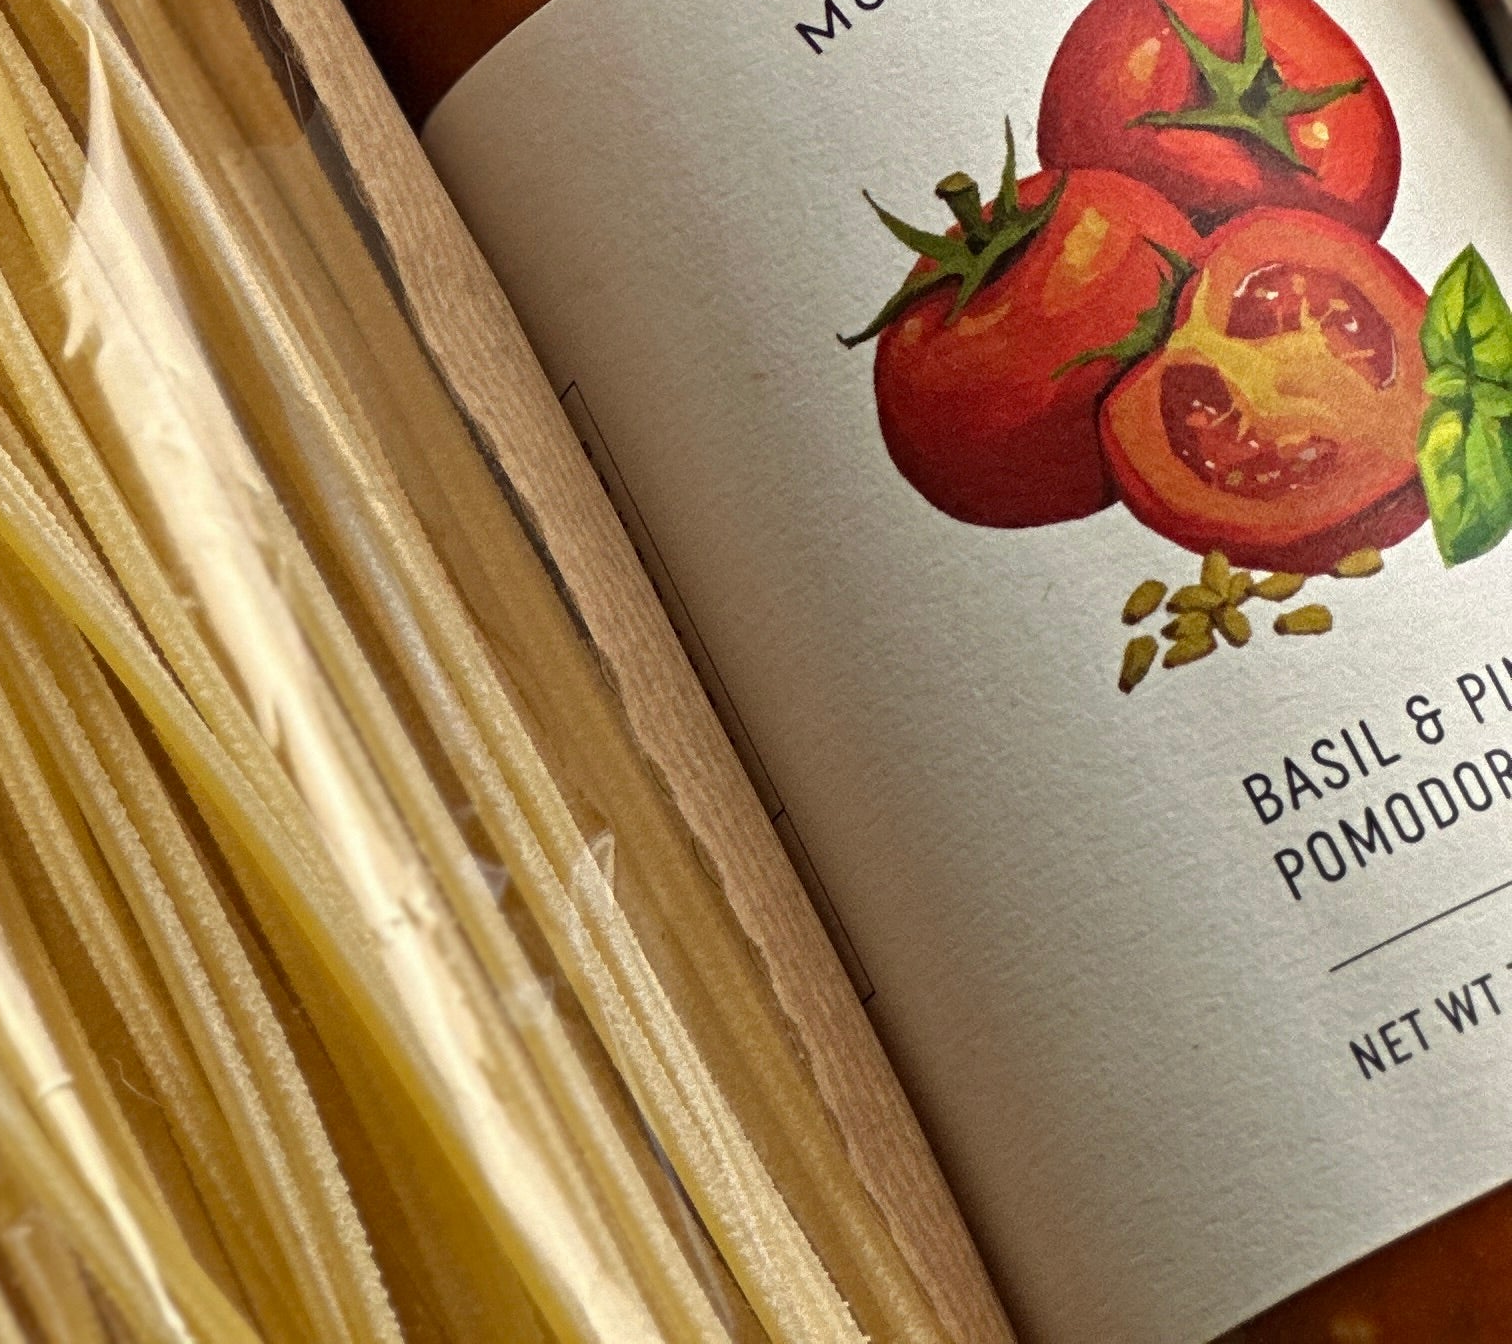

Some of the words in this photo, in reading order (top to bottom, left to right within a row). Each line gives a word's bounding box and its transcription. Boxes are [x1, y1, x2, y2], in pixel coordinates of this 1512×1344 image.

[1242, 720, 1402, 826] BASIL
[1405, 694, 1445, 745] &
[1456, 656, 1512, 725] PI
[1274, 748, 1512, 901] POMODOR
[1348, 1007, 1430, 1080] NET
[1433, 972, 1502, 1034] WT
